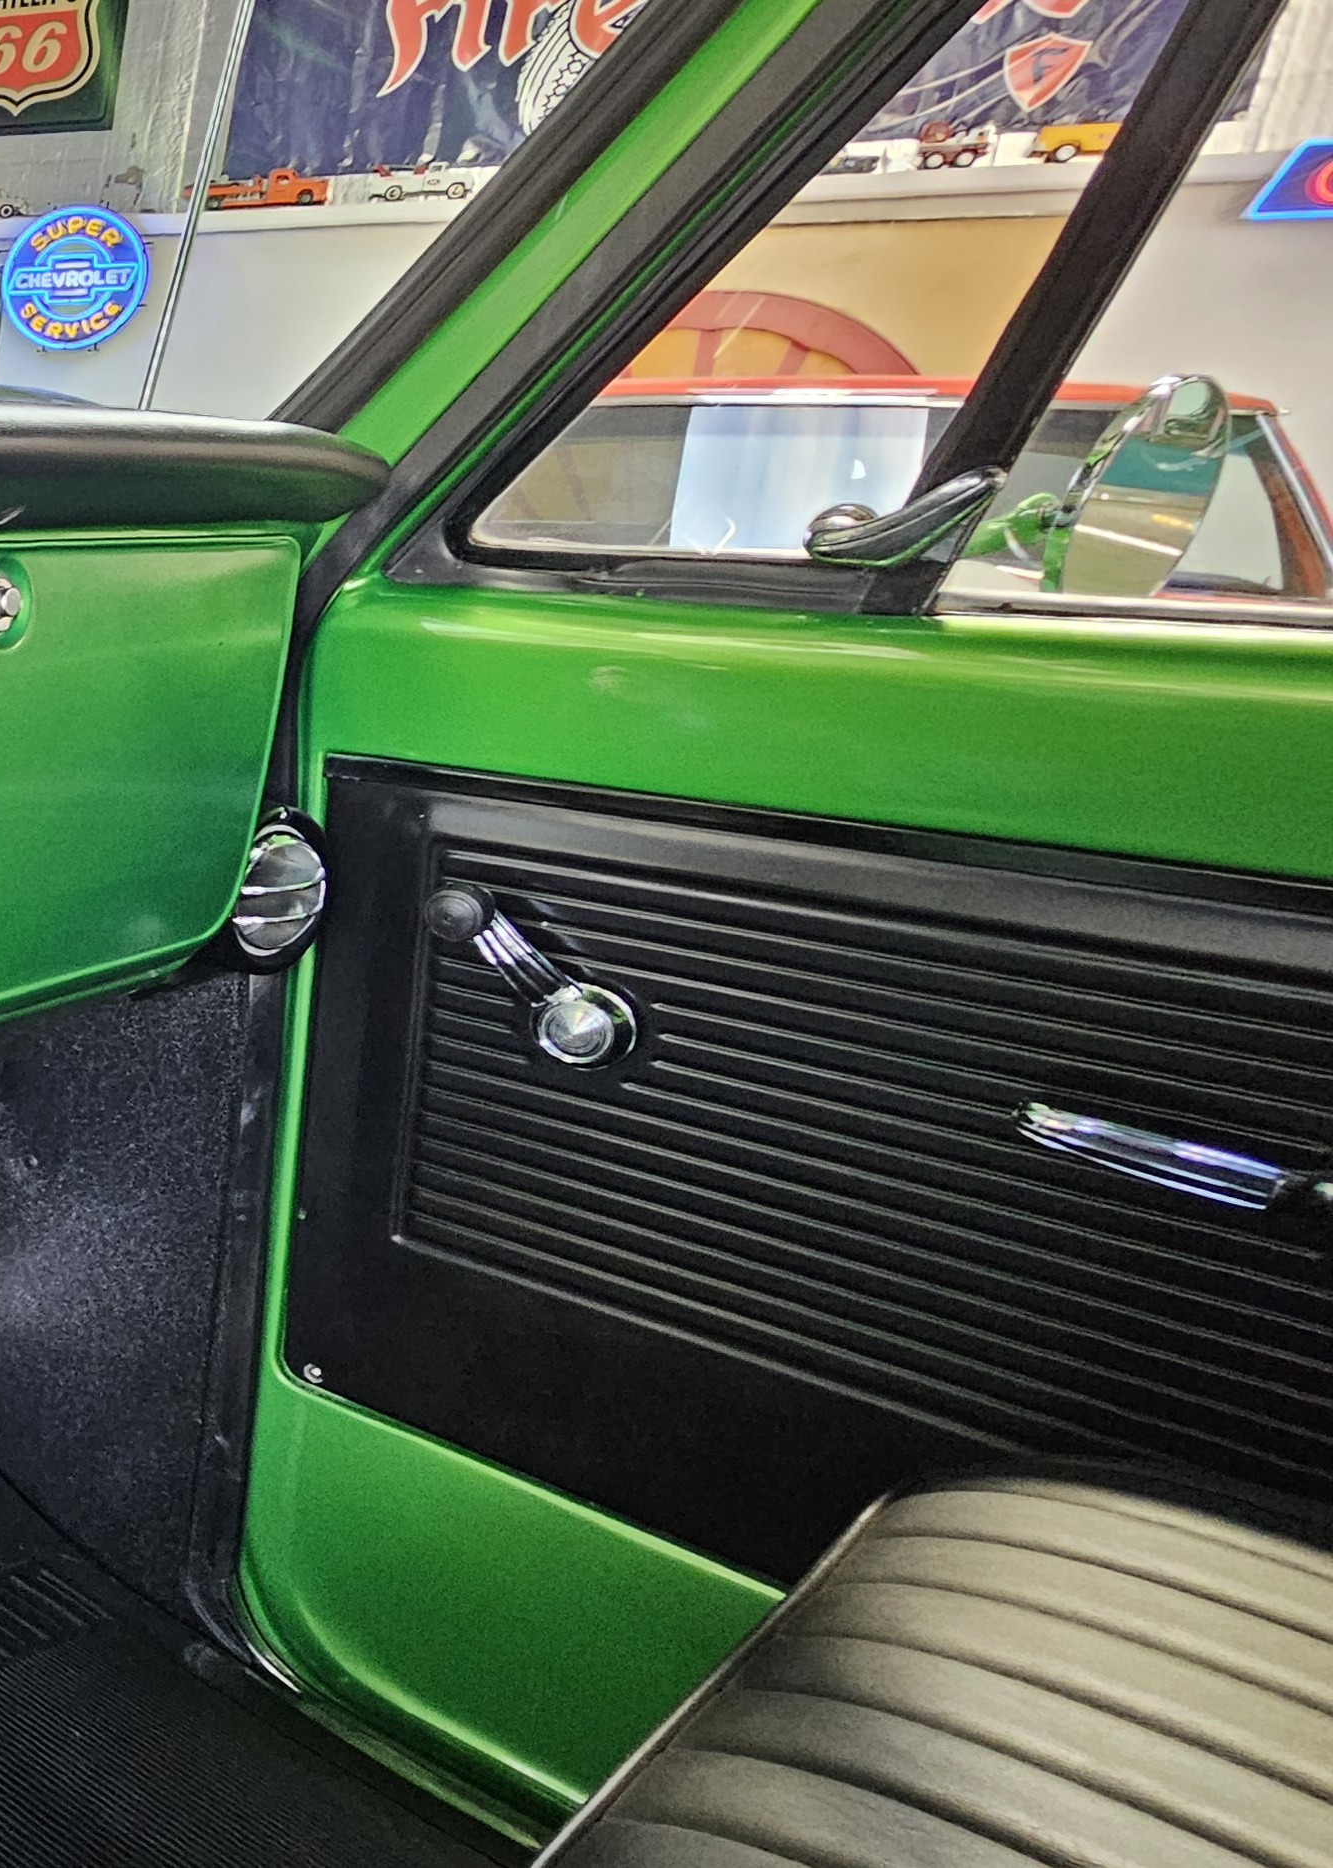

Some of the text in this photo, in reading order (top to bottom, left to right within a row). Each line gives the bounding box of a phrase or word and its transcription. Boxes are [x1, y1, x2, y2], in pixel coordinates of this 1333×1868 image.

[30, 215, 123, 252] SUPER
[15, 268, 133, 289] CHEVROLET
[20, 300, 123, 340] SERVICE
